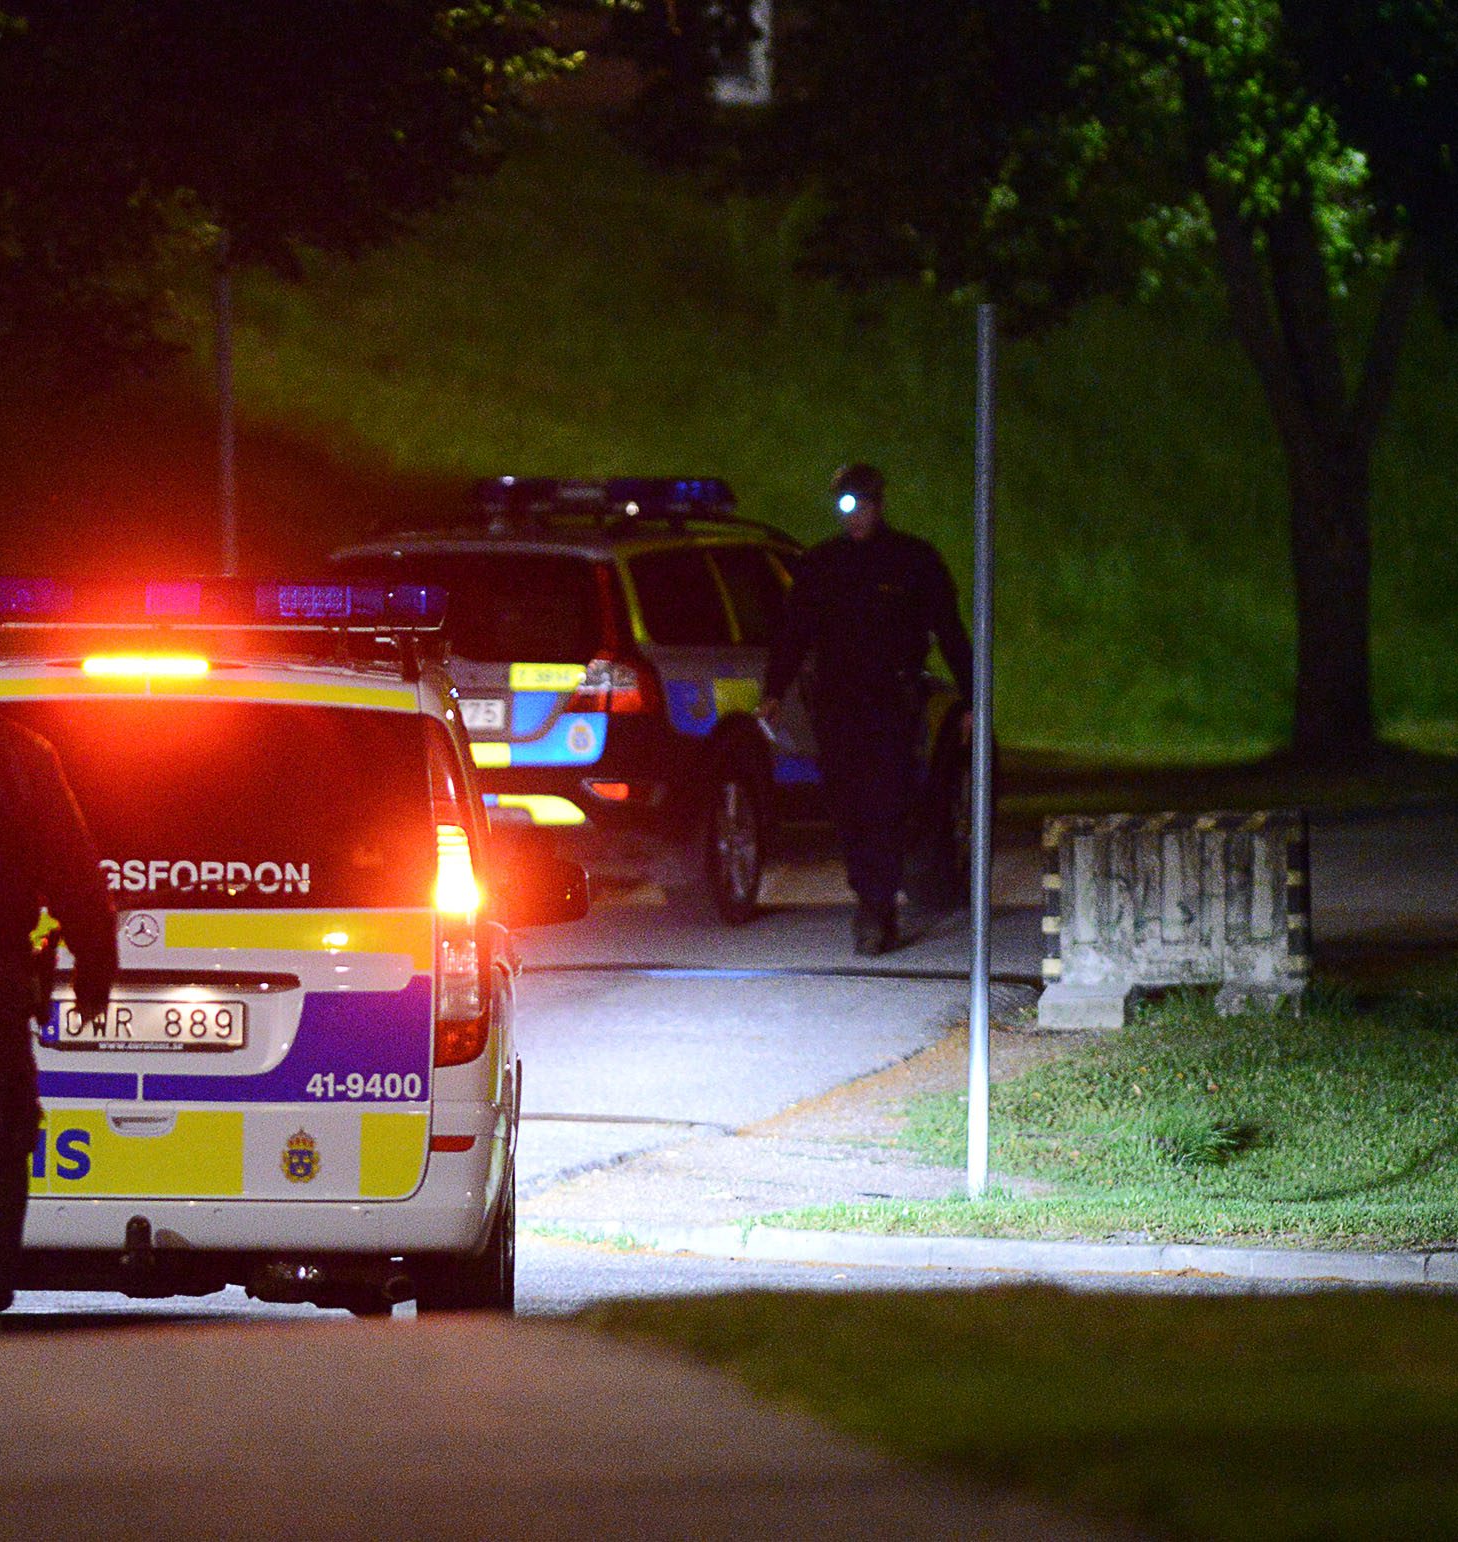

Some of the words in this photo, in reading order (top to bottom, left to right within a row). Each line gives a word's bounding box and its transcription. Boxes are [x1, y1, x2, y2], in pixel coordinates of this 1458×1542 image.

[460, 700, 498, 724] 75
[47, 1025, 55, 1035] S
[164, 1008, 233, 1039] 889
[305, 1072, 422, 1099] 41-9400
